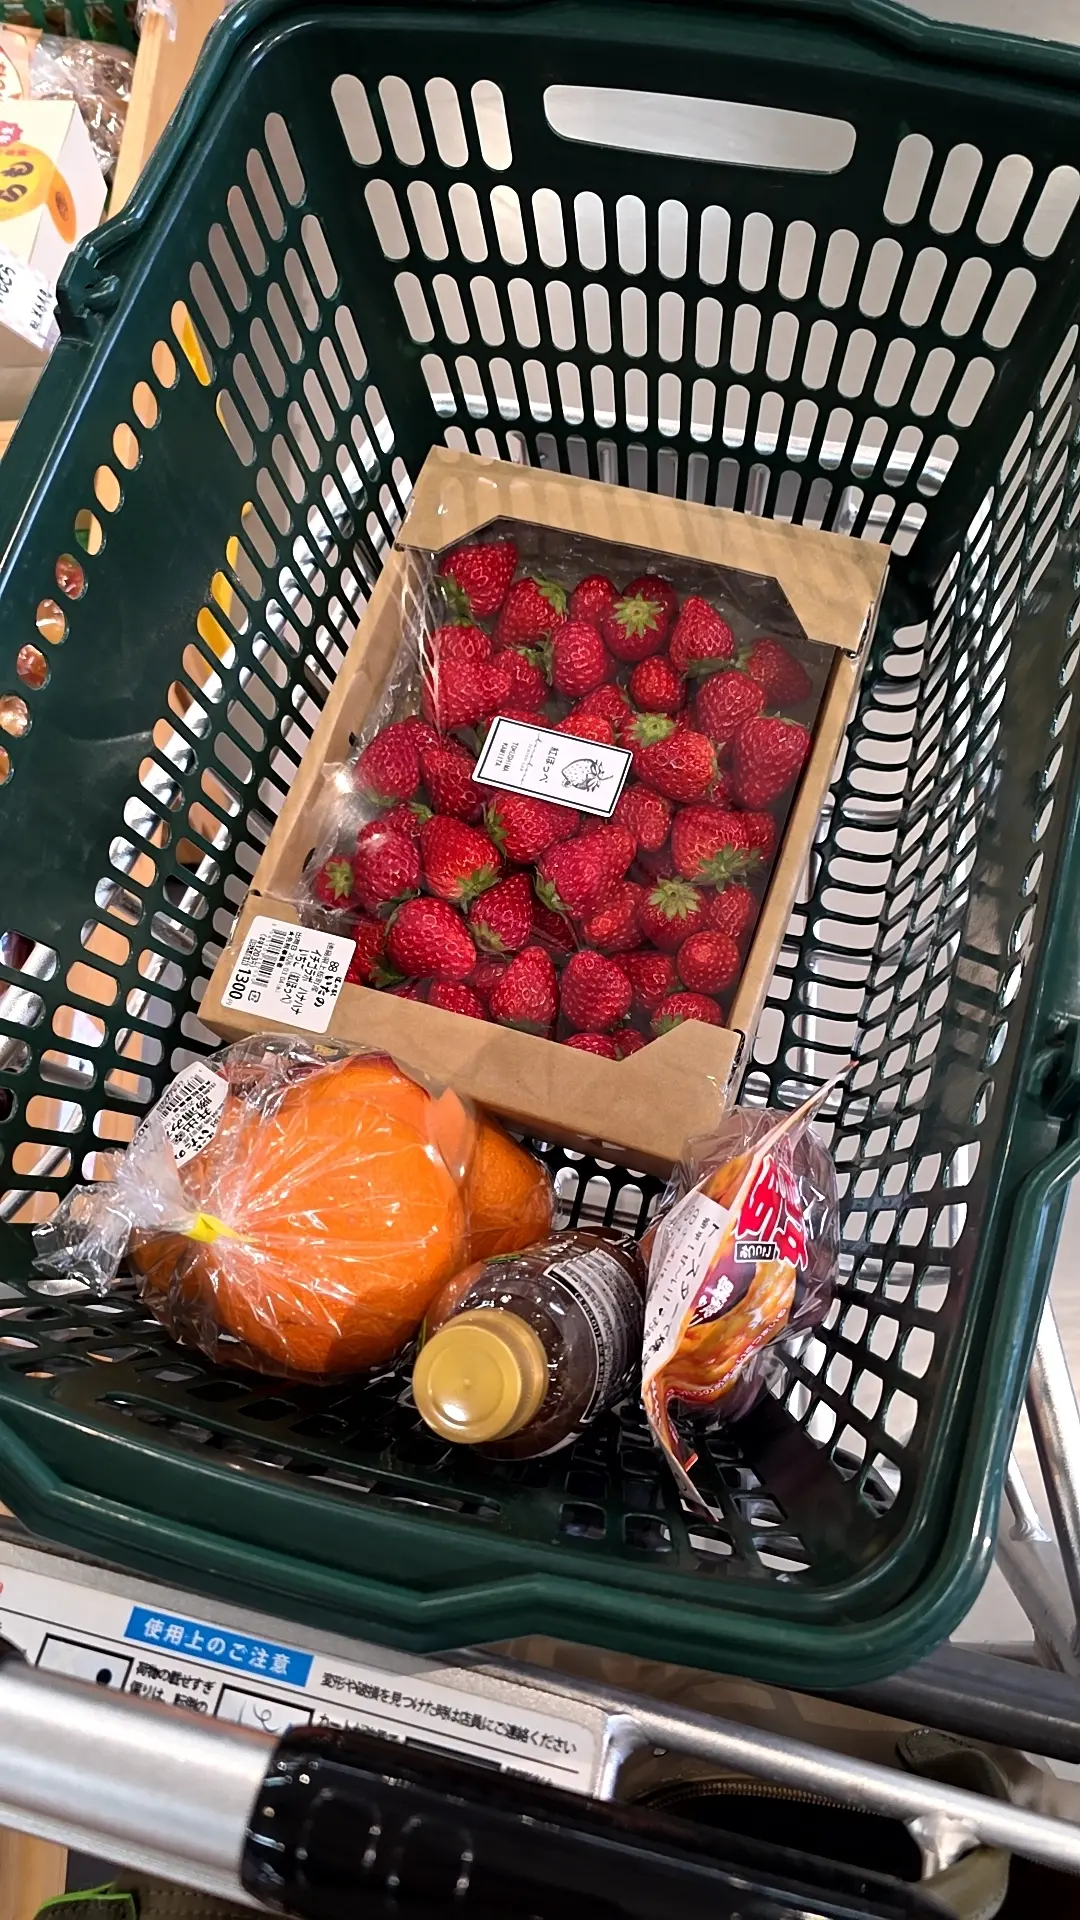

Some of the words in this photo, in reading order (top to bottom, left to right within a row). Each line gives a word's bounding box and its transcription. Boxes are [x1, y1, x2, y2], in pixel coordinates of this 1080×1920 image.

[501, 741, 519, 772] TOKUSHIMA
[538, 746, 559, 783] 紅ほっぺ
[301, 948, 322, 982] イチゴラボ
[289, 986, 309, 1015] ハナハナ
[313, 973, 334, 1008] いたの
[143, 1617, 292, 1676] 使用上のご注意
